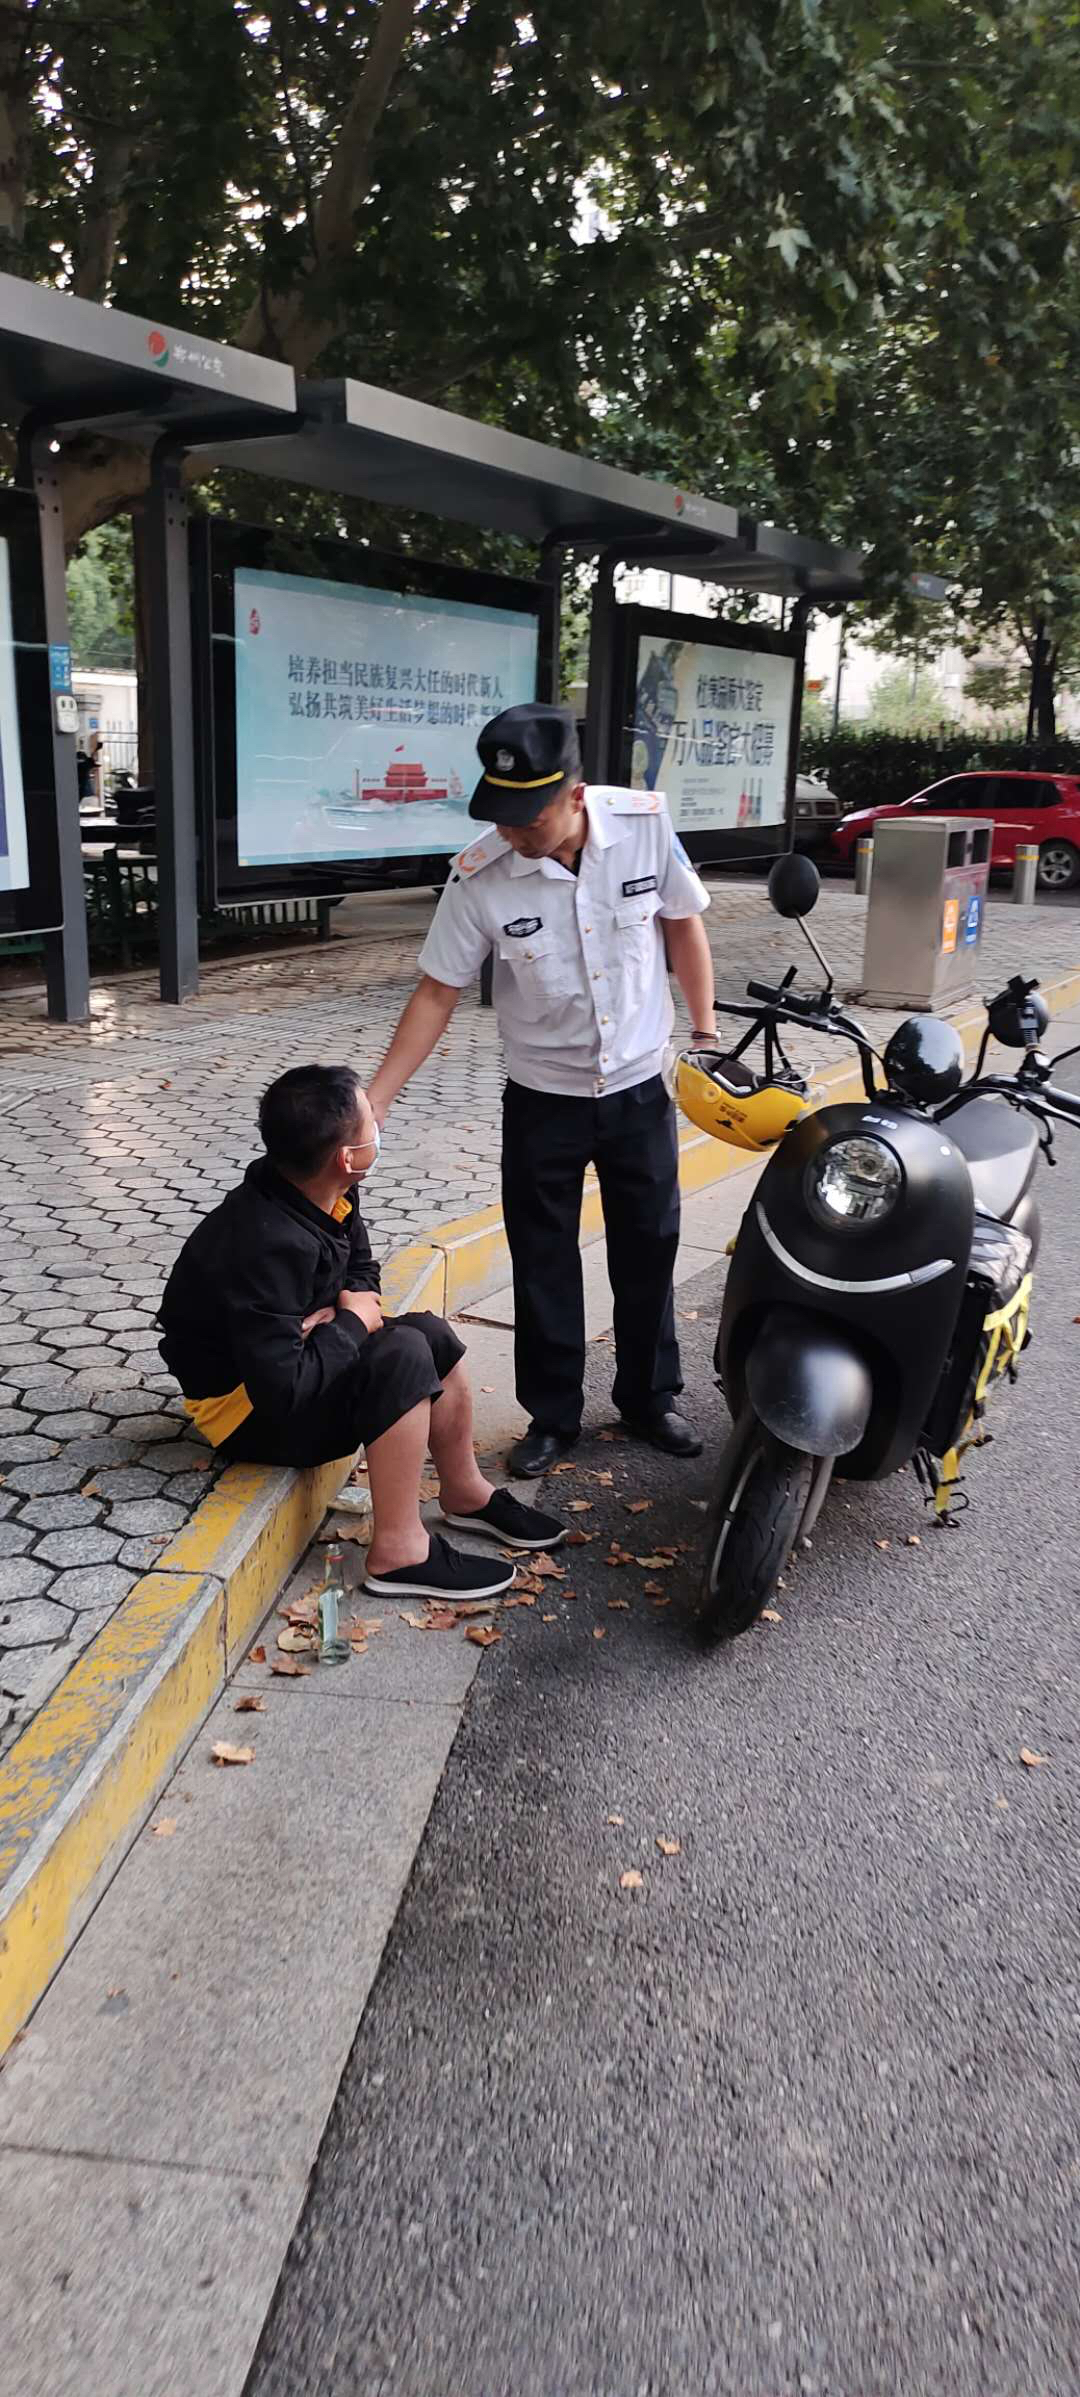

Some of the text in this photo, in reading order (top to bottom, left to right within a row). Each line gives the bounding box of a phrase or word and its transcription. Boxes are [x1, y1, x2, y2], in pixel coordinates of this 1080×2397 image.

[288, 654, 504, 699] 培养担当民族复兴大任的时代新人
